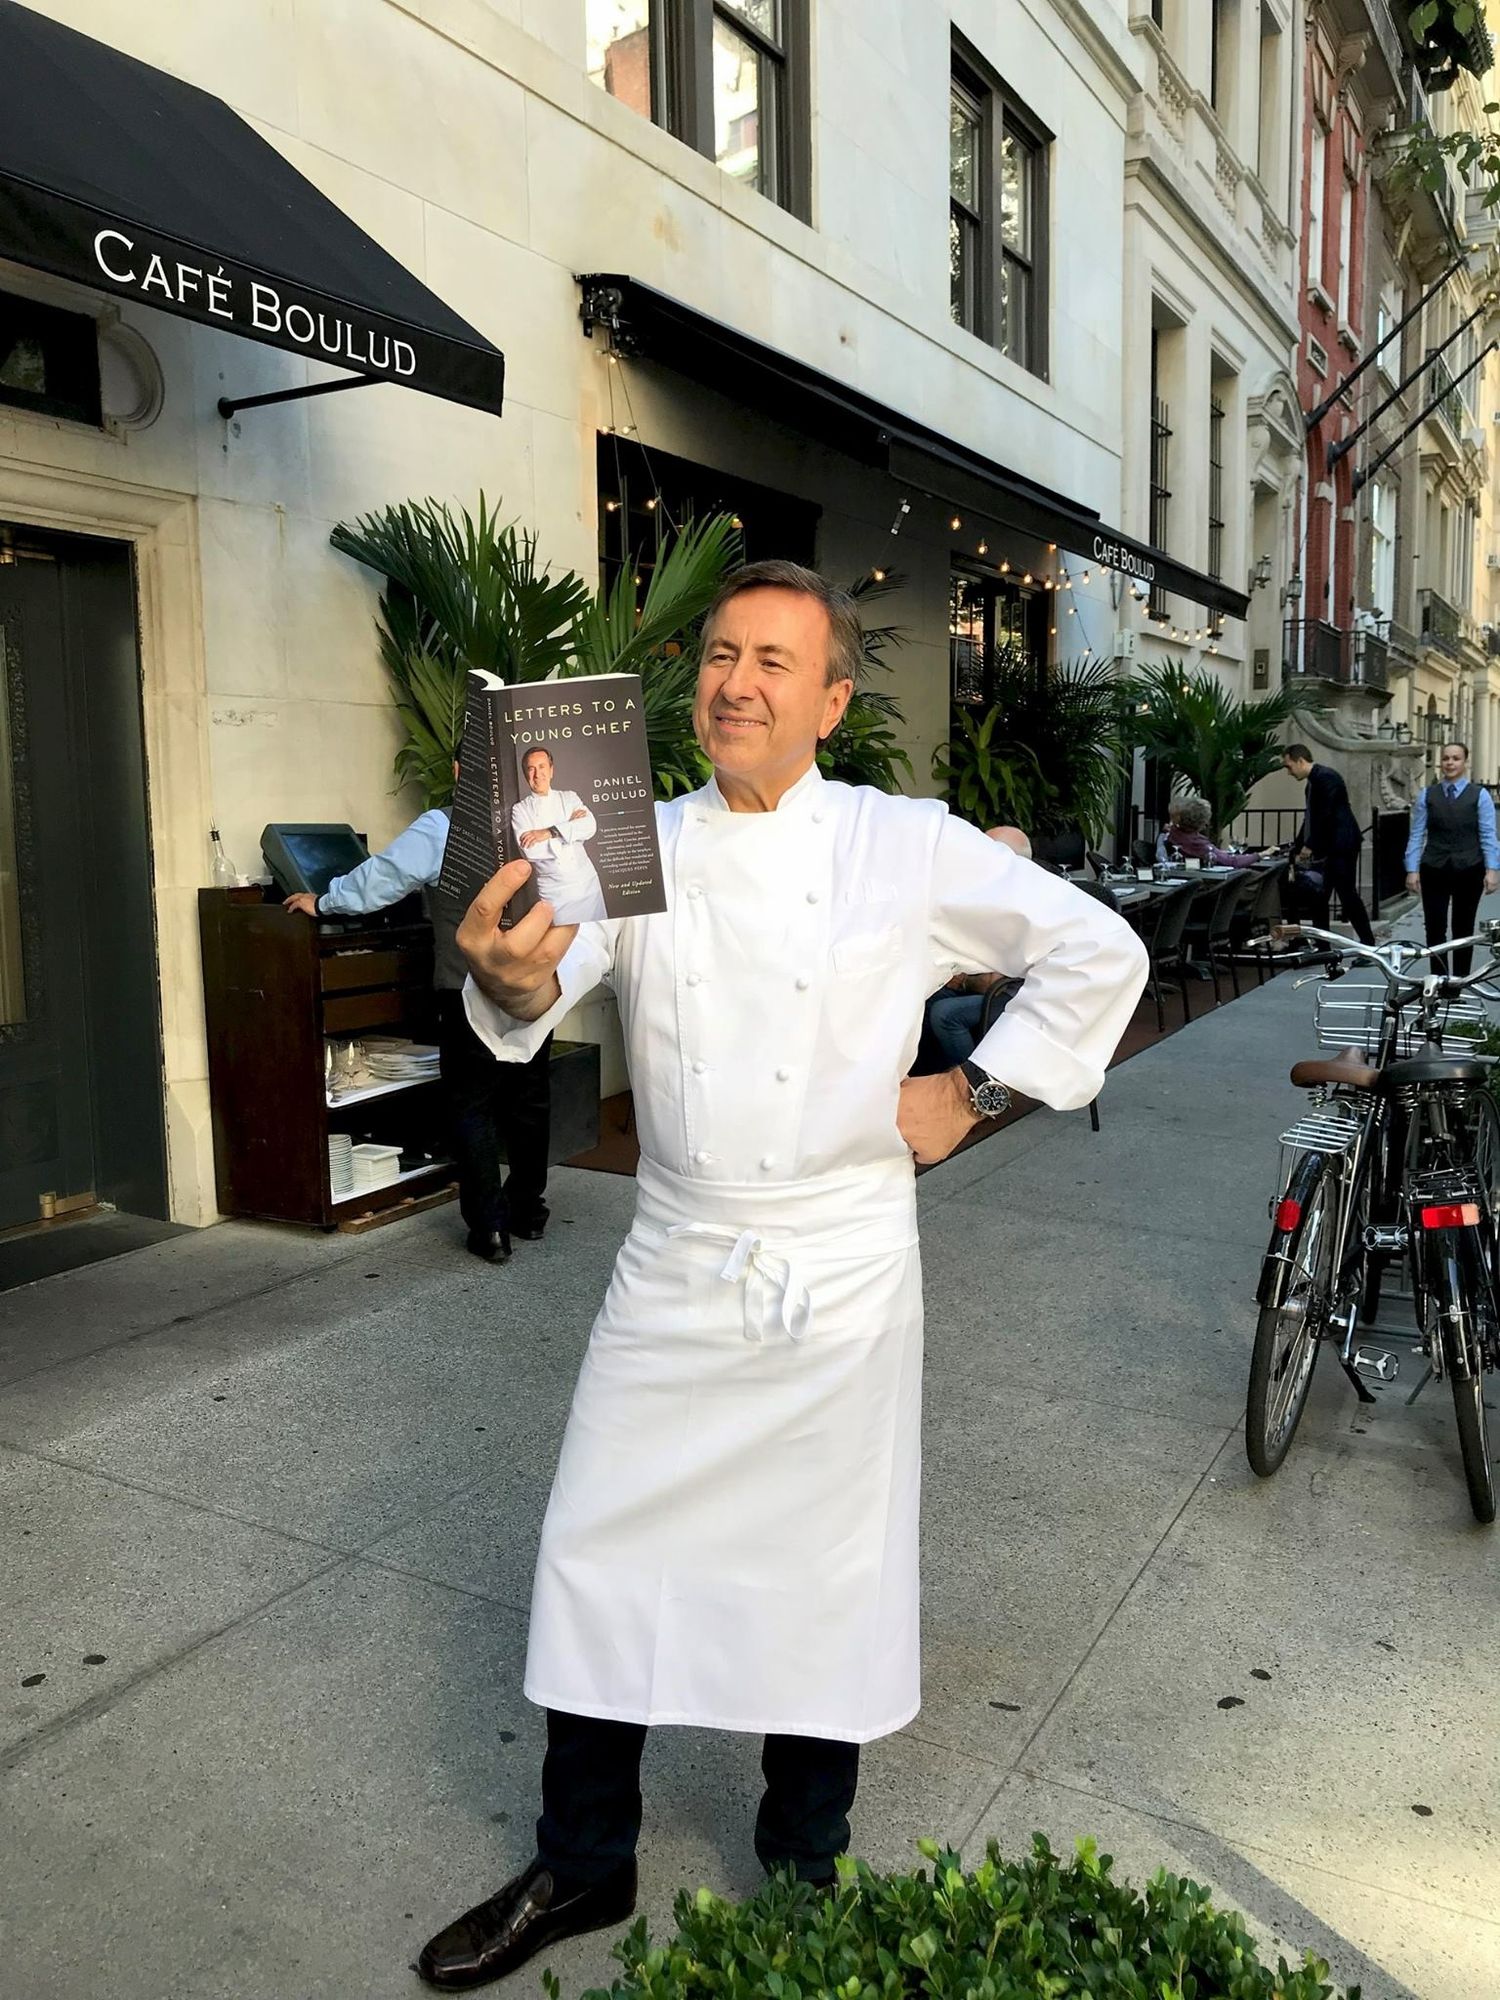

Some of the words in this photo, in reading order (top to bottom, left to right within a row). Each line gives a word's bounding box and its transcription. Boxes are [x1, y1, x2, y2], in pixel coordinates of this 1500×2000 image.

[94, 229, 234, 320] CAFÉ
[251, 281, 416, 376] BOULUD
[1093, 536, 1119, 567] CAFÉ
[1121, 547, 1156, 581] BOULUD
[504, 703, 583, 723] LETTERS
[592, 700, 615, 713] TO
[625, 698, 636, 710] A
[510, 726, 573, 745] YOUNG
[581, 720, 632, 736] CHEF
[490, 756, 500, 805] LETTERS
[593, 775, 642, 788] DANIEL
[592, 789, 647, 803] BOULUD
[495, 810, 502, 823] TO
[495, 827, 502, 835] A
[497, 839, 505, 868] YOUN
